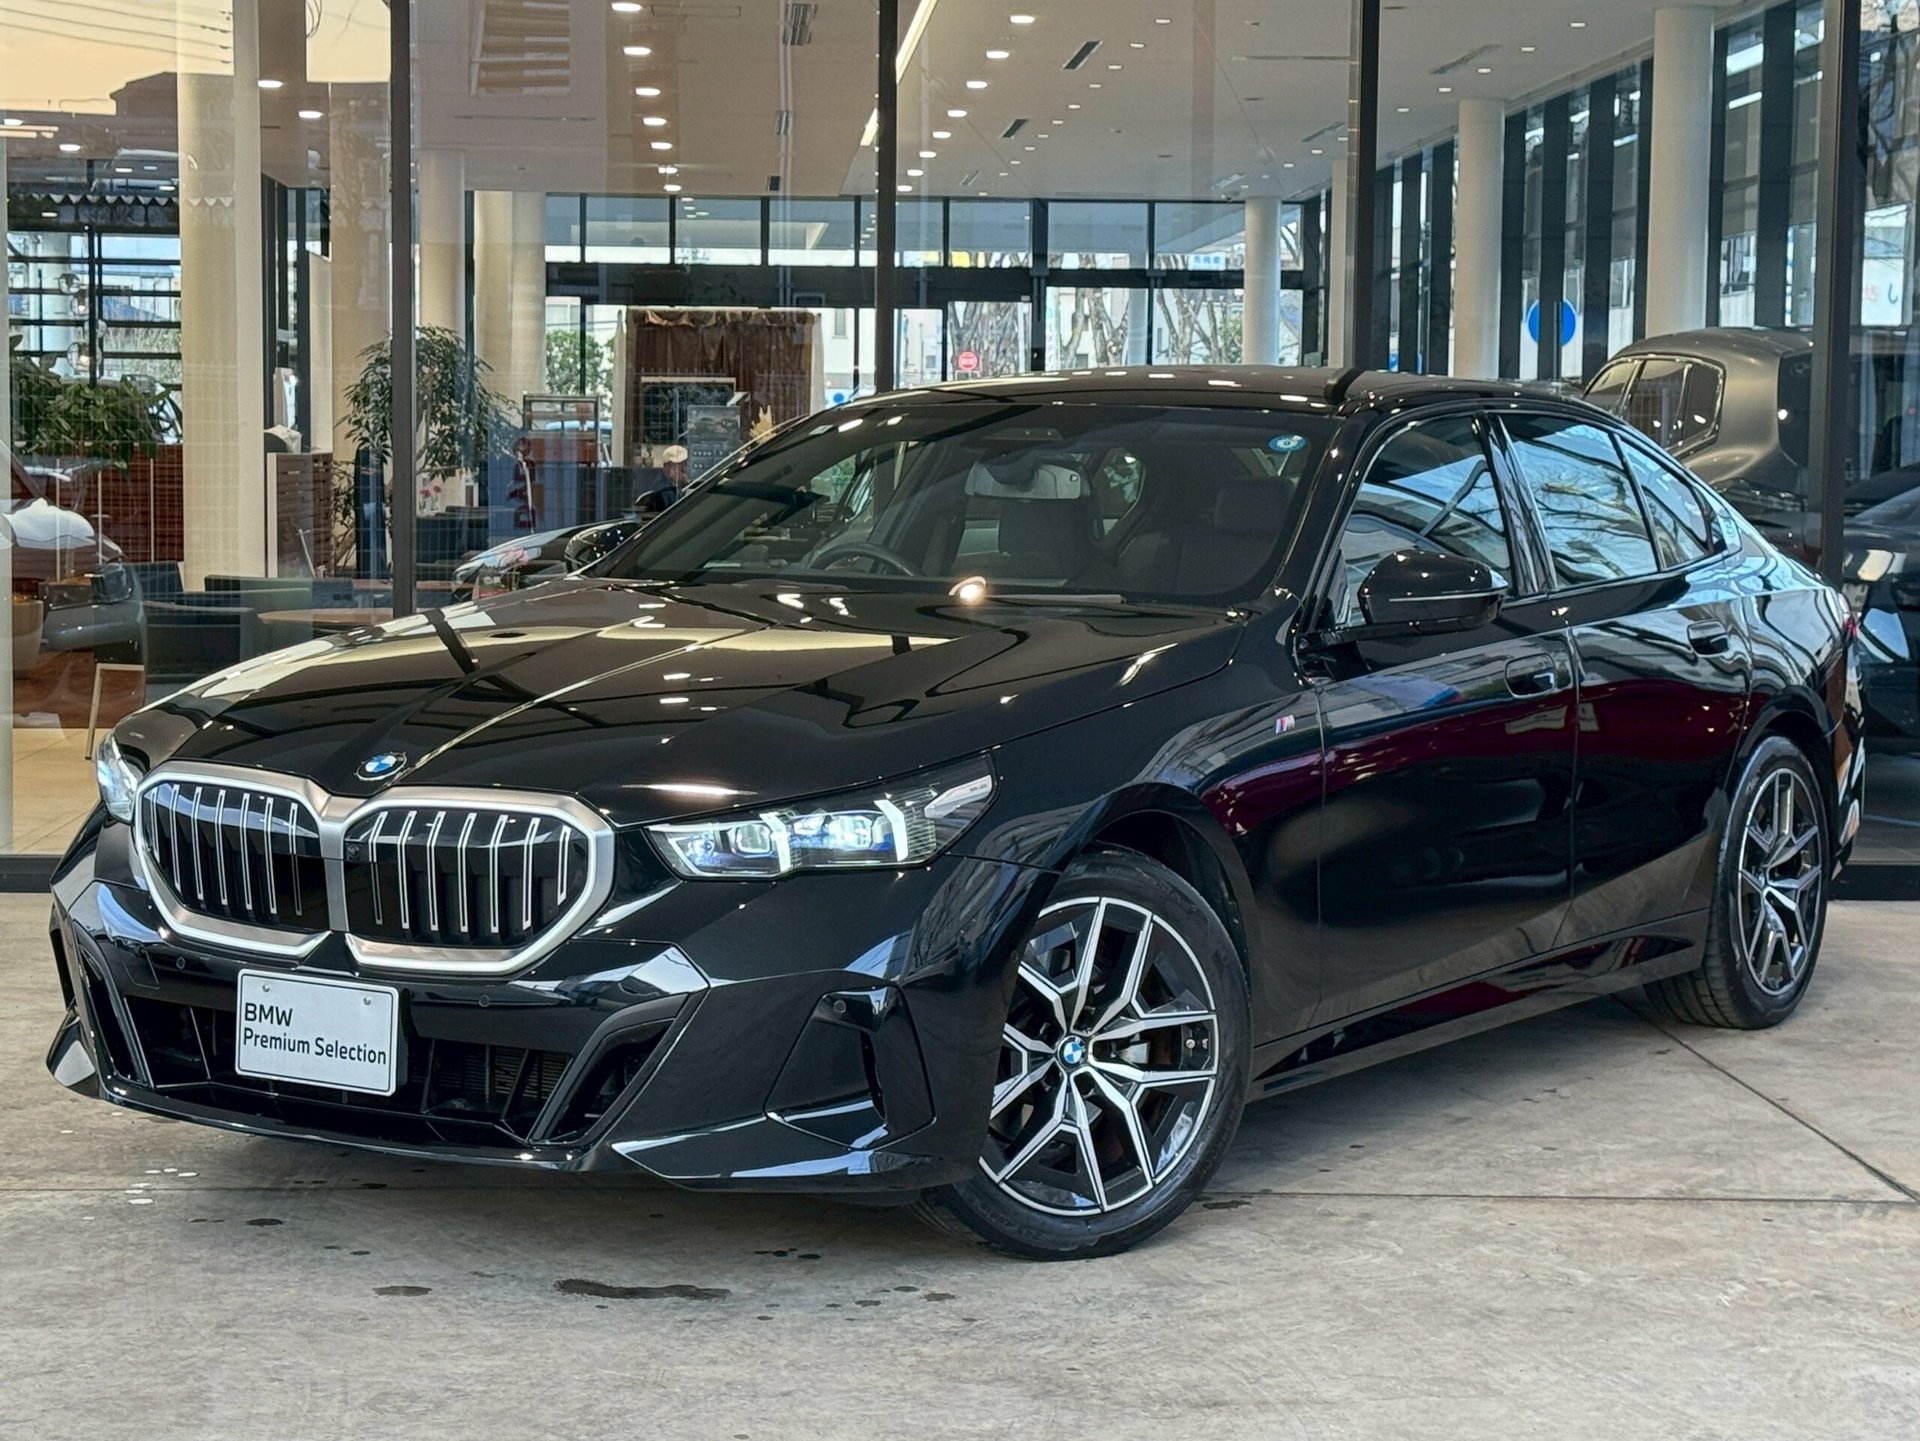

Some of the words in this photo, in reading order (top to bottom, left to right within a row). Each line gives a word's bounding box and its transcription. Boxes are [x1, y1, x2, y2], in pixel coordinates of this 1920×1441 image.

[244, 1002, 293, 1027] BMW
[243, 1027, 310, 1054] Premium
[314, 1037, 387, 1065] Selection
